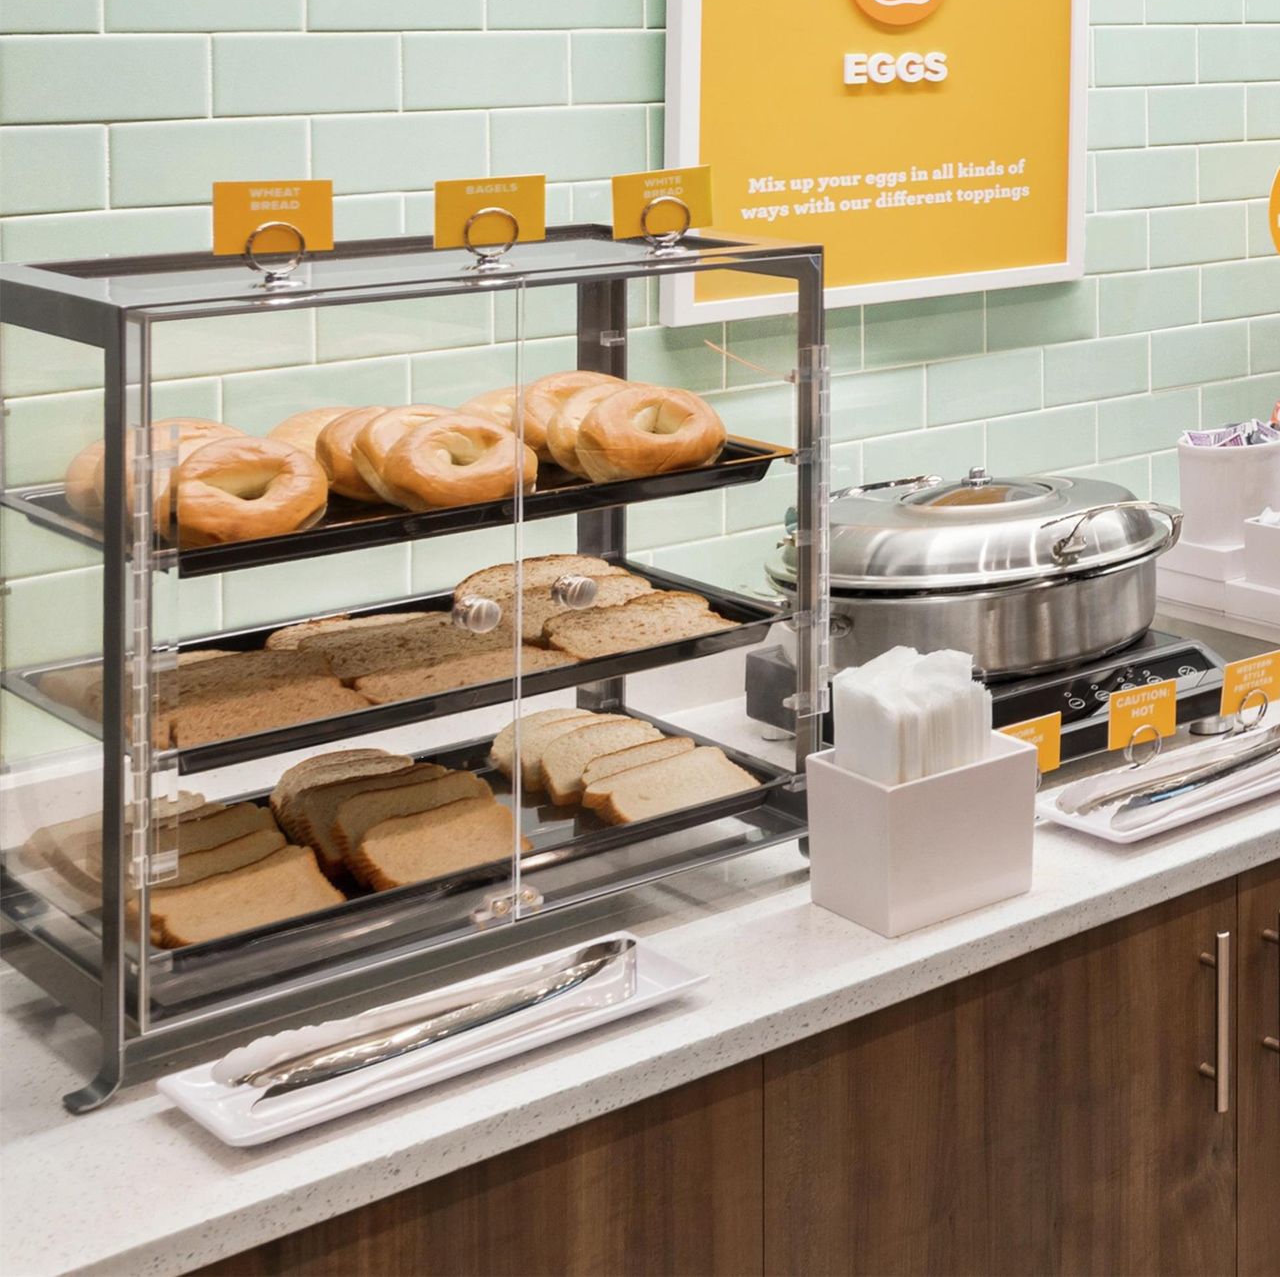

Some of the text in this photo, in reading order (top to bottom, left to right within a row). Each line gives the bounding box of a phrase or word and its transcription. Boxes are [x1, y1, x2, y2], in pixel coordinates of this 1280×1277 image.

[844, 52, 948, 85] EGGS
[644, 175, 682, 187] WHITE
[748, 158, 1026, 195] Mix up your eggs in all kinds of
[249, 187, 301, 198] WHEAT
[466, 182, 518, 195] BAGELS
[250, 200, 300, 211] BREAD
[740, 184, 1030, 222] ways with our different toppings
[1243, 670, 1266, 684] STYLE
[1116, 688, 1170, 709] CAUTION:
[1131, 706, 1155, 719] HOT
